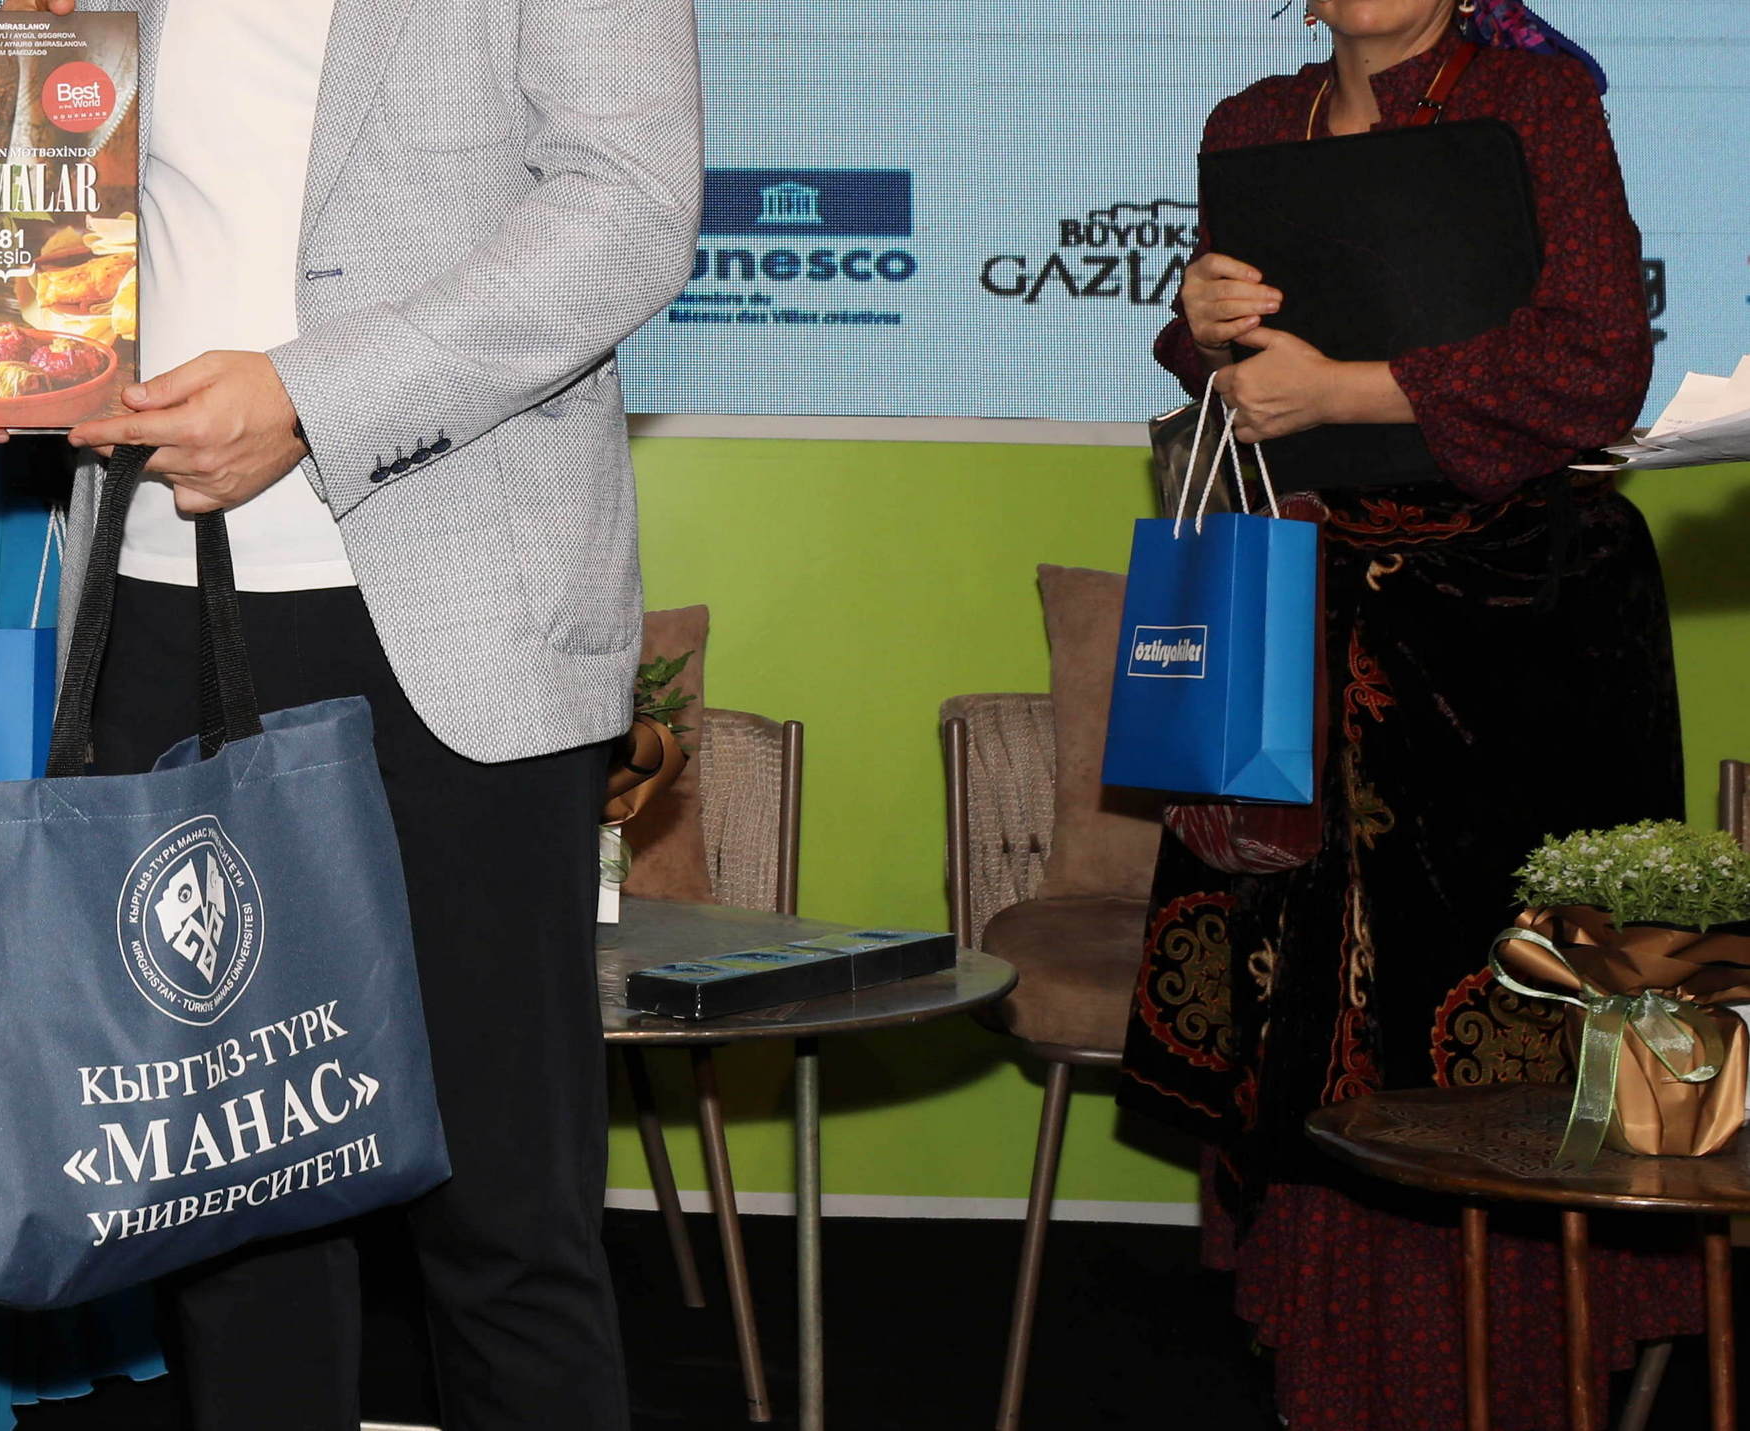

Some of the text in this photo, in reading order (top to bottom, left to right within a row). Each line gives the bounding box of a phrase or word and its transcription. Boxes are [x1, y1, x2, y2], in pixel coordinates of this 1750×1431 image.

[57, 81, 100, 101] Best
[73, 99, 100, 108] World
[87, 1133, 383, 1247] УНИВЕРСИТЕТИ
